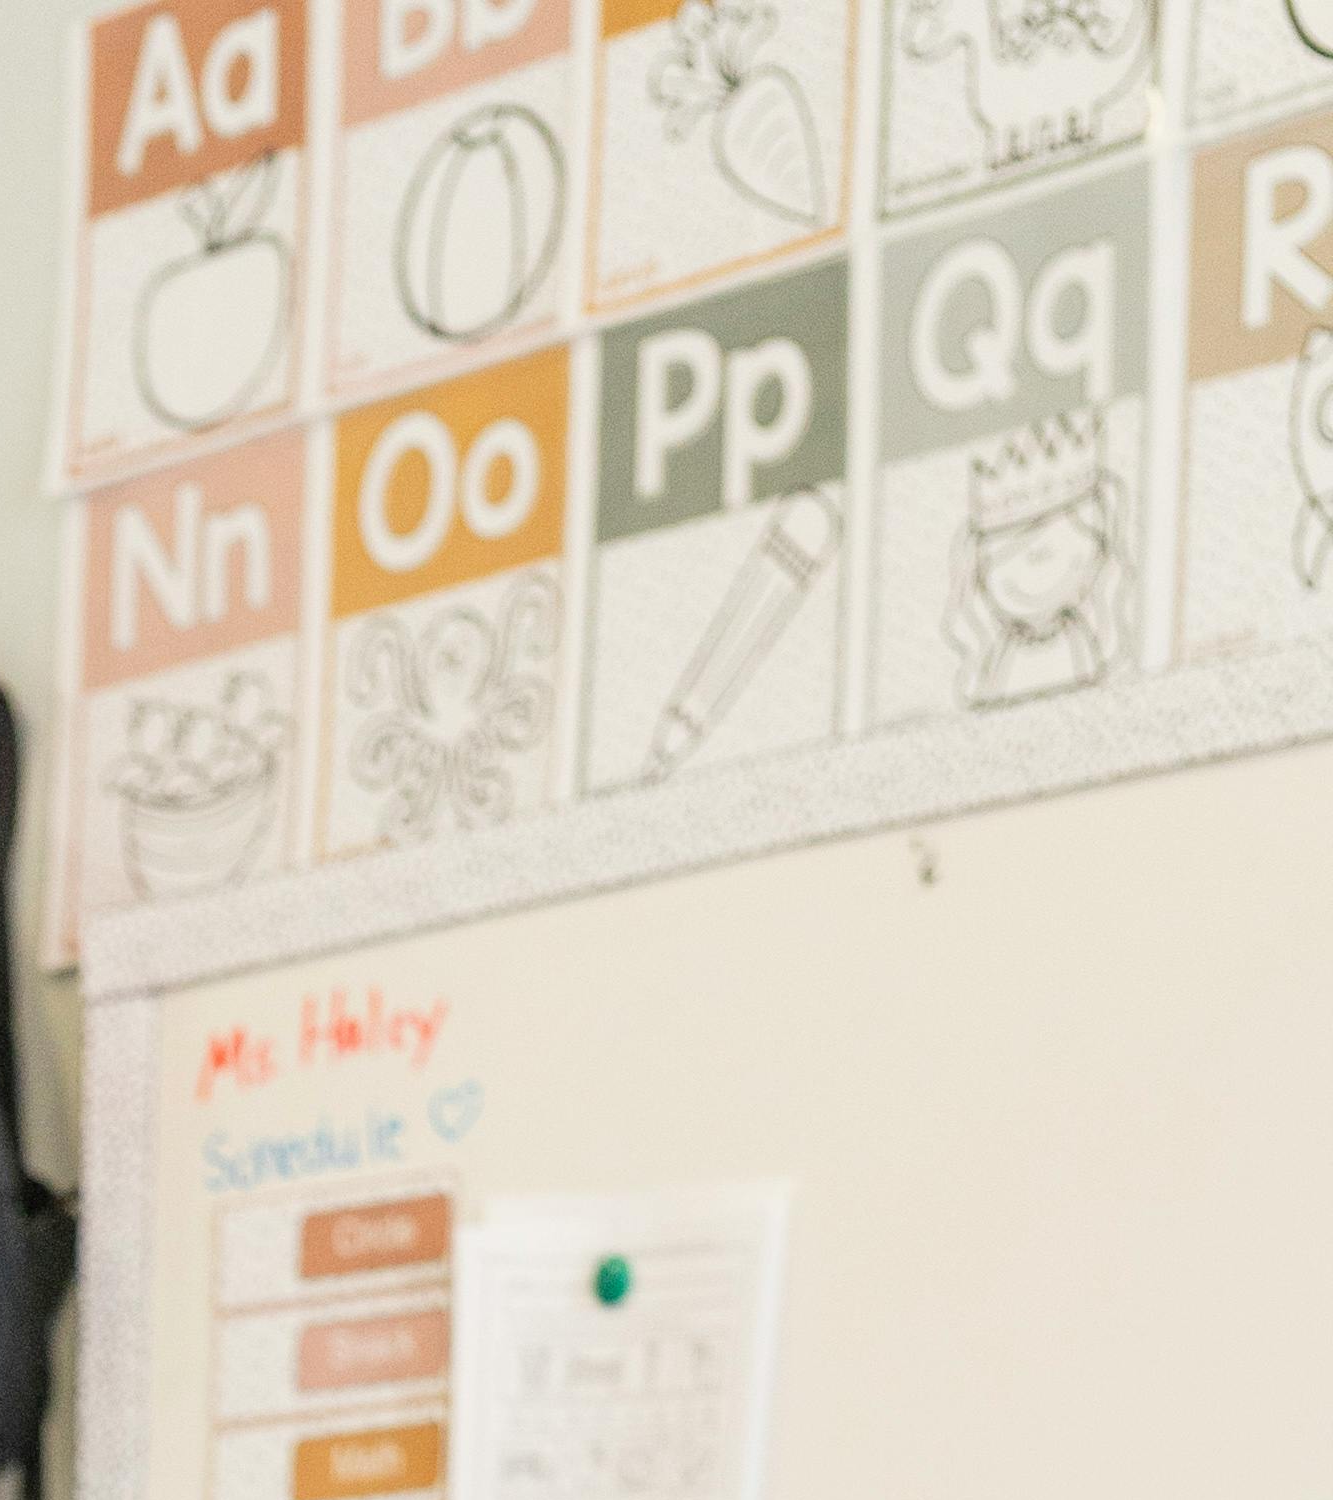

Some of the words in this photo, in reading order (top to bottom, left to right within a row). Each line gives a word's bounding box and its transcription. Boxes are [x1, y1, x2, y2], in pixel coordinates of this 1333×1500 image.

[117, 8, 279, 175] Aa
[910, 238, 1119, 412] Qq
[357, 411, 539, 572] Oo
[634, 328, 813, 512] Pp
[109, 482, 271, 651] Nn
